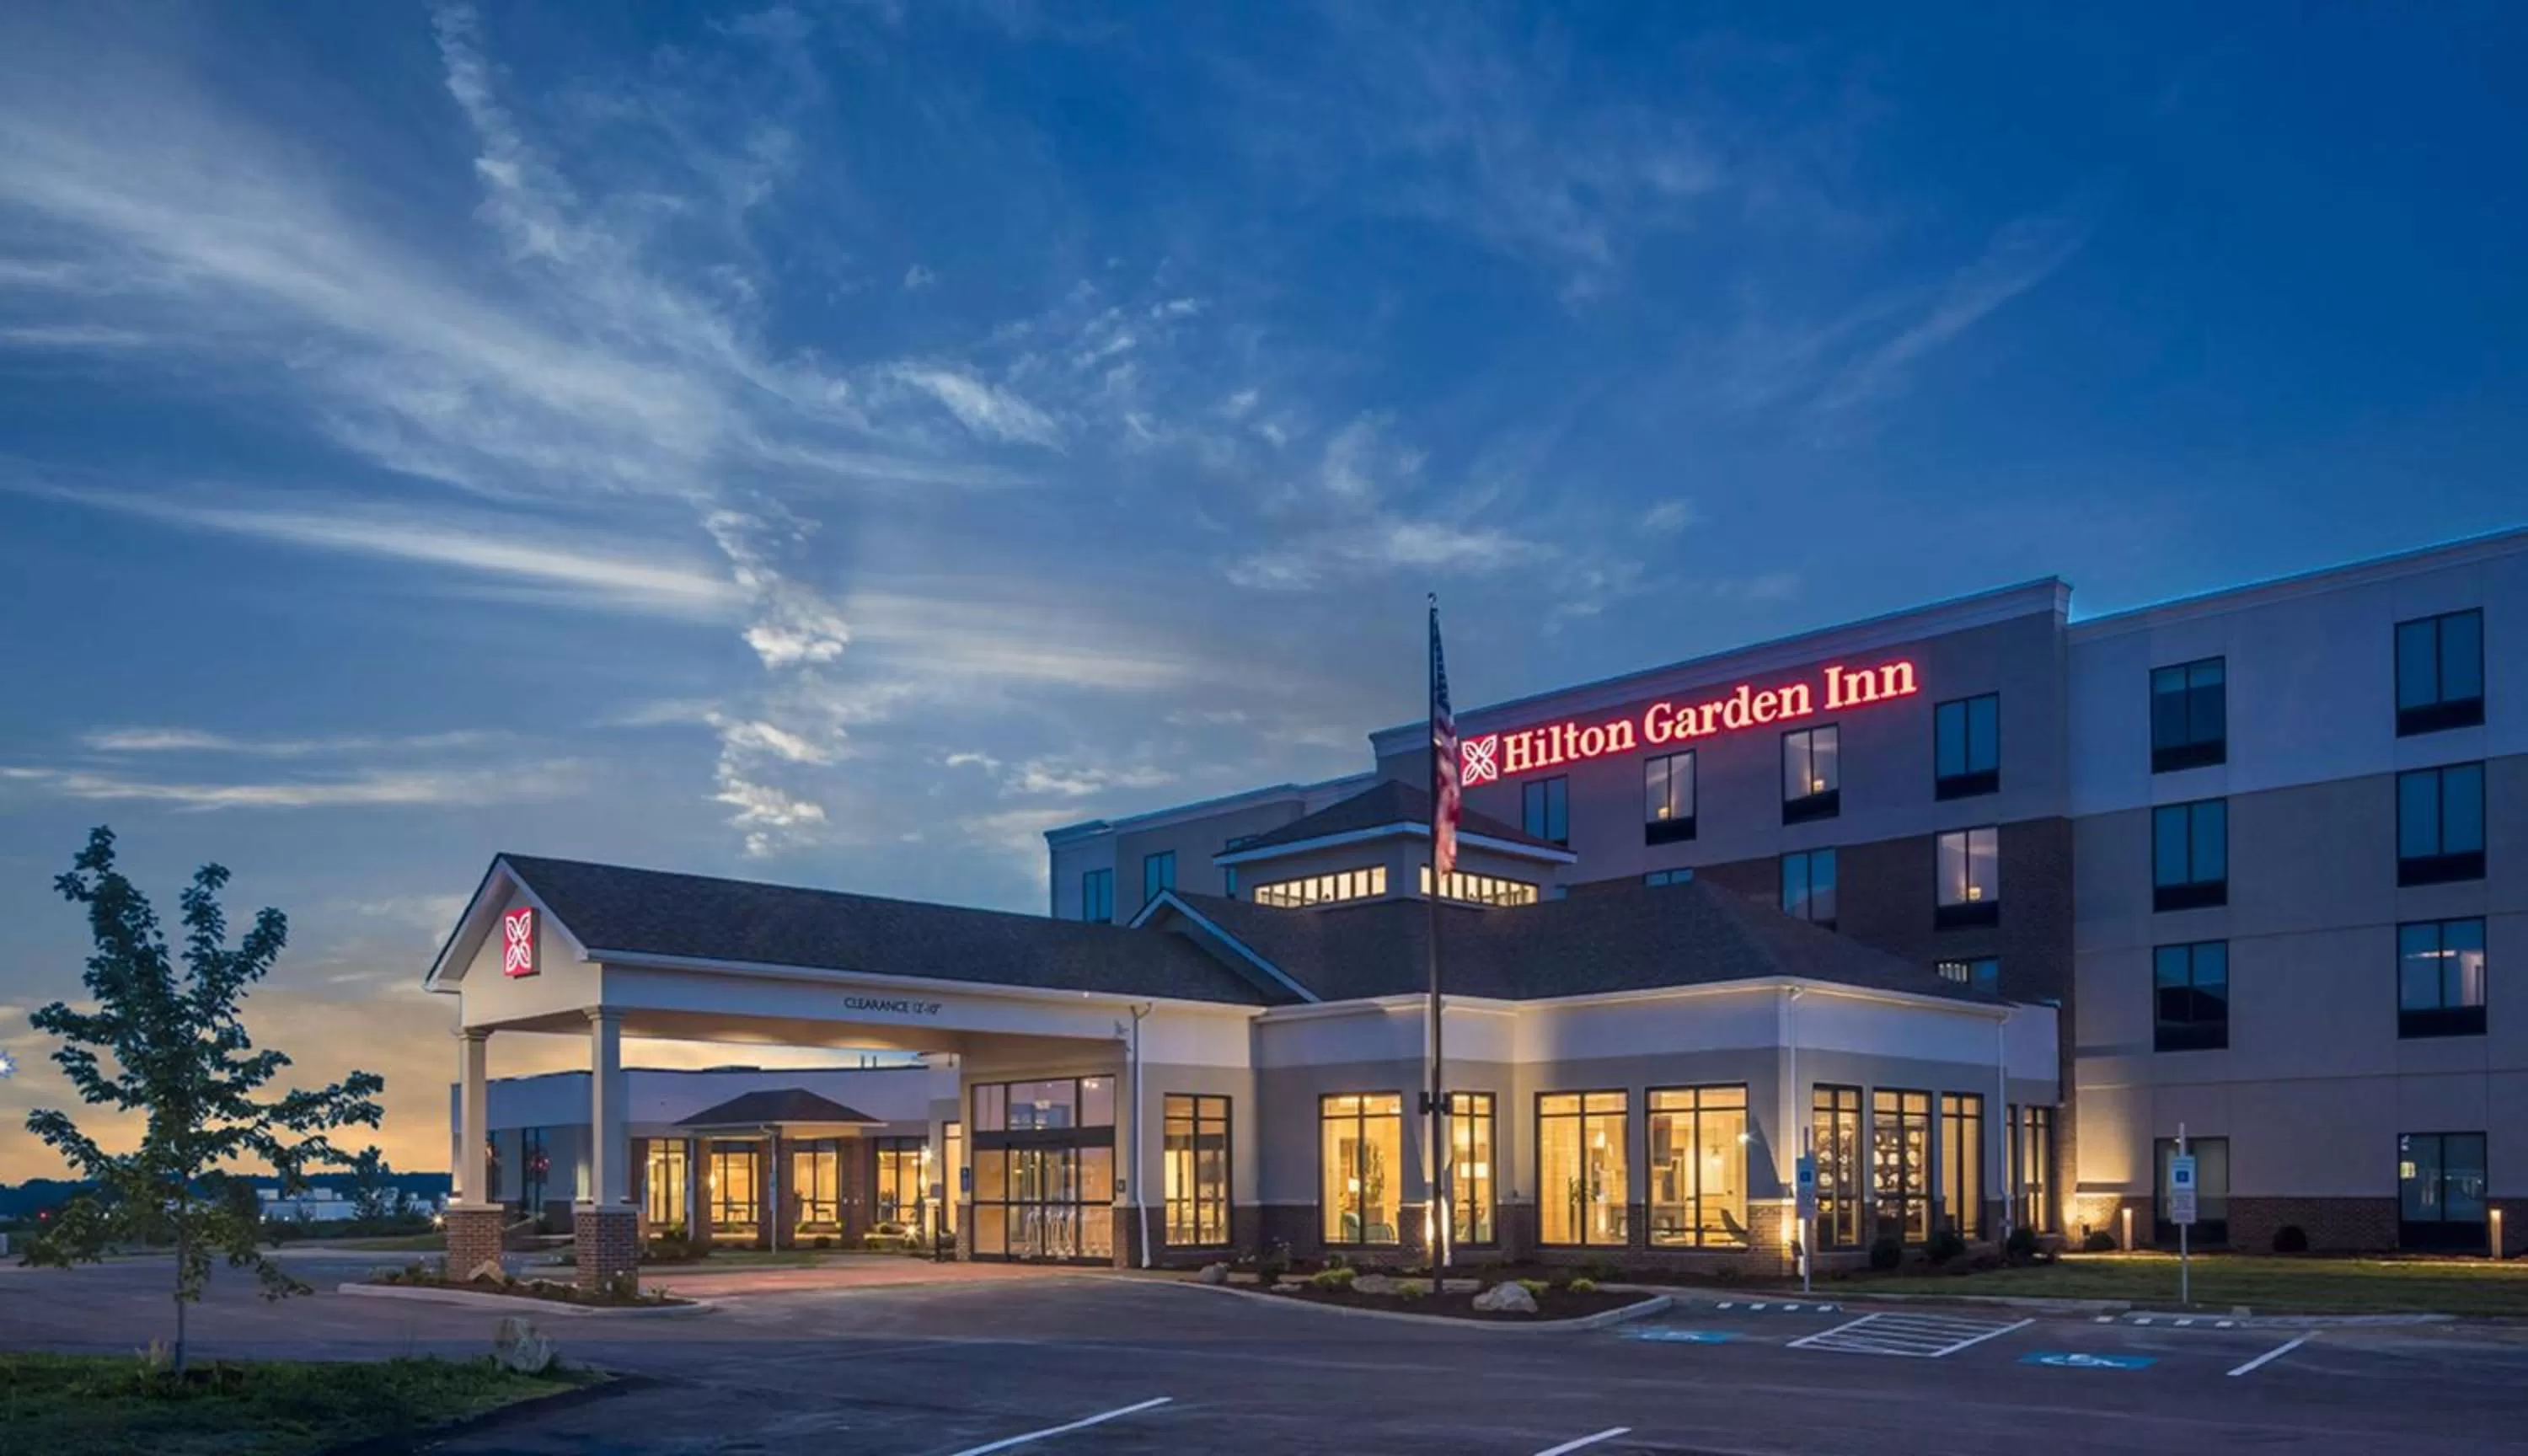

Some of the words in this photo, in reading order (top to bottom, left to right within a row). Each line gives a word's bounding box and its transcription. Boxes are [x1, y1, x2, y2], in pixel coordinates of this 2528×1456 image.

[1502, 719, 1636, 774] Hilton
[1644, 683, 1813, 743] Garden
[1824, 661, 1917, 709] Inn
[844, 997, 908, 1014] CLEARANCE
